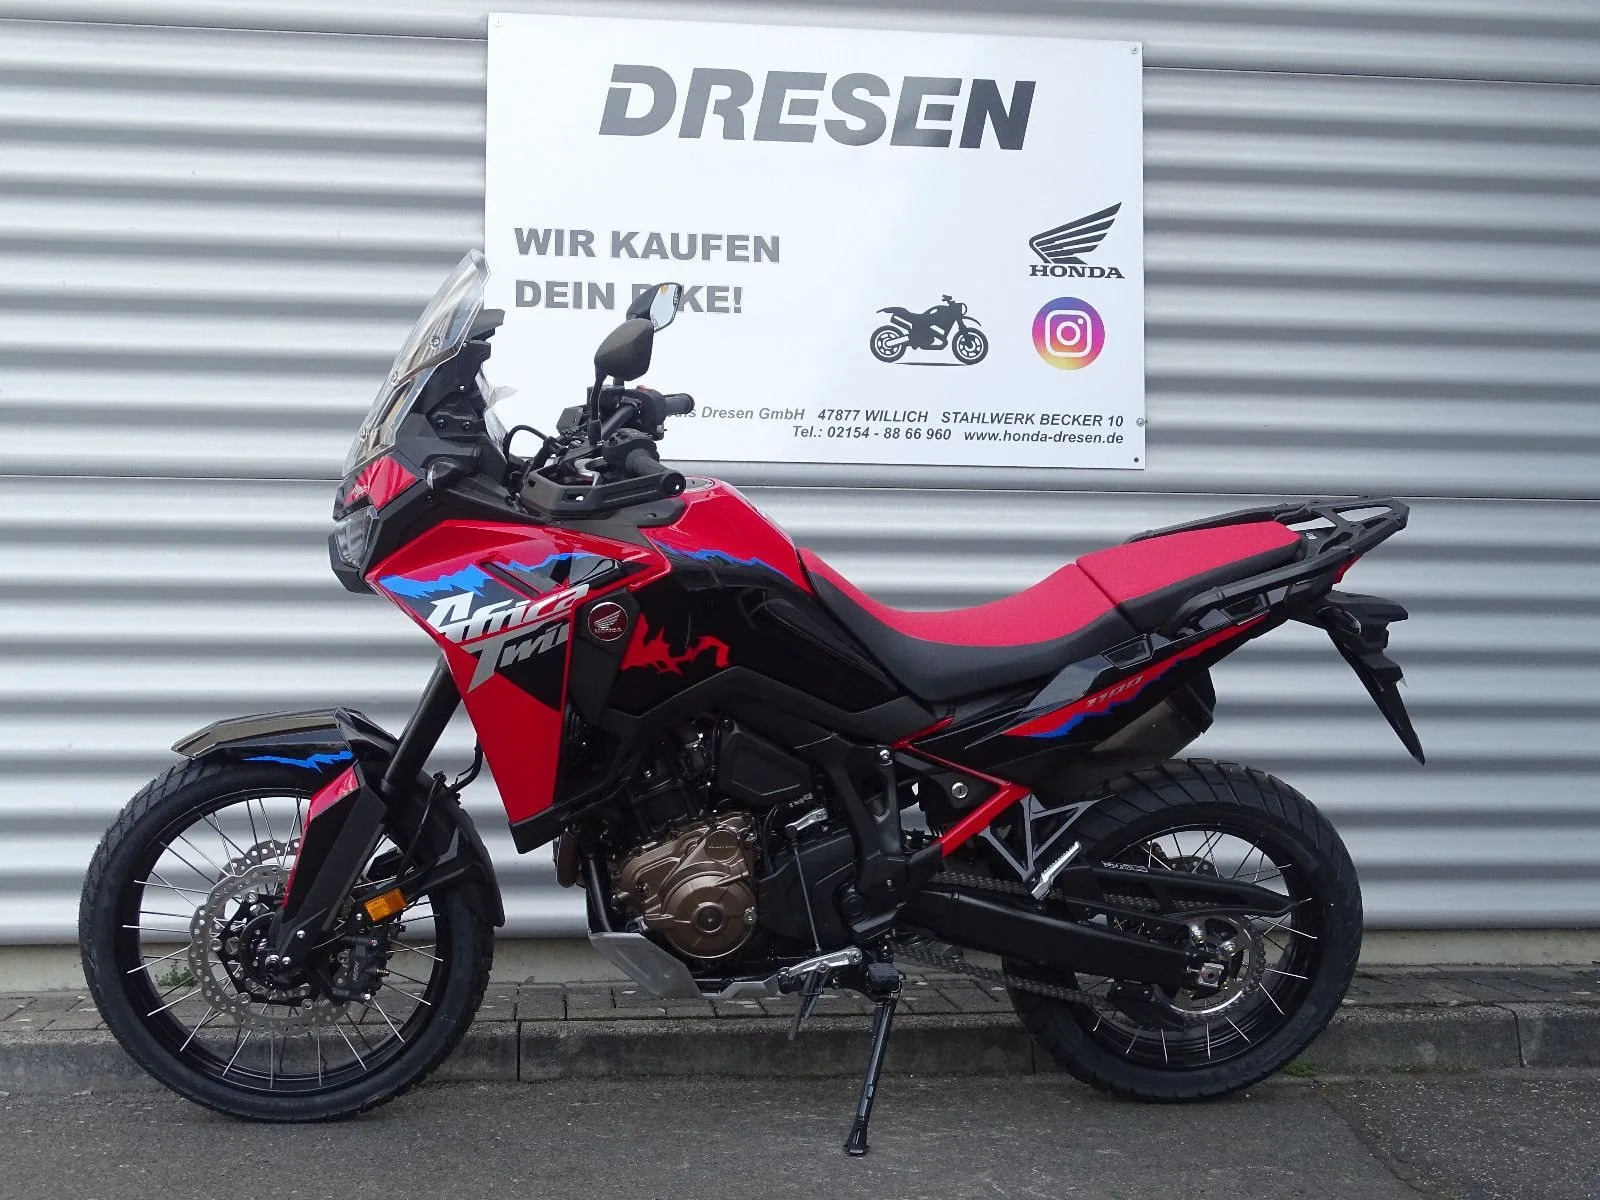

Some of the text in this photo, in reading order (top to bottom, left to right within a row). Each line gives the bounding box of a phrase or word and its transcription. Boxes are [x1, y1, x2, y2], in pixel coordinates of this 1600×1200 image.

[598, 63, 1037, 151] DRESEN
[514, 227, 780, 263] WIR KAUFEN
[1029, 264, 1125, 279] HONDA
[515, 279, 743, 314] DEIN KE!
[701, 406, 753, 419] Dresen
[758, 407, 805, 420] GmbH
[817, 408, 860, 422] 47877
[865, 409, 929, 423] WILLICH
[941, 411, 1036, 425] STAHLWERK
[1039, 413, 1103, 427] BECKER
[1108, 415, 1124, 427] 10
[792, 425, 822, 438] Tel.:
[827, 426, 870, 439] 02154
[883, 427, 901, 440] 88
[905, 428, 922, 440] 66
[926, 428, 952, 440] 960
[964, 430, 1124, 444] www.honda-dresen.de
[427, 583, 590, 644] Africa
